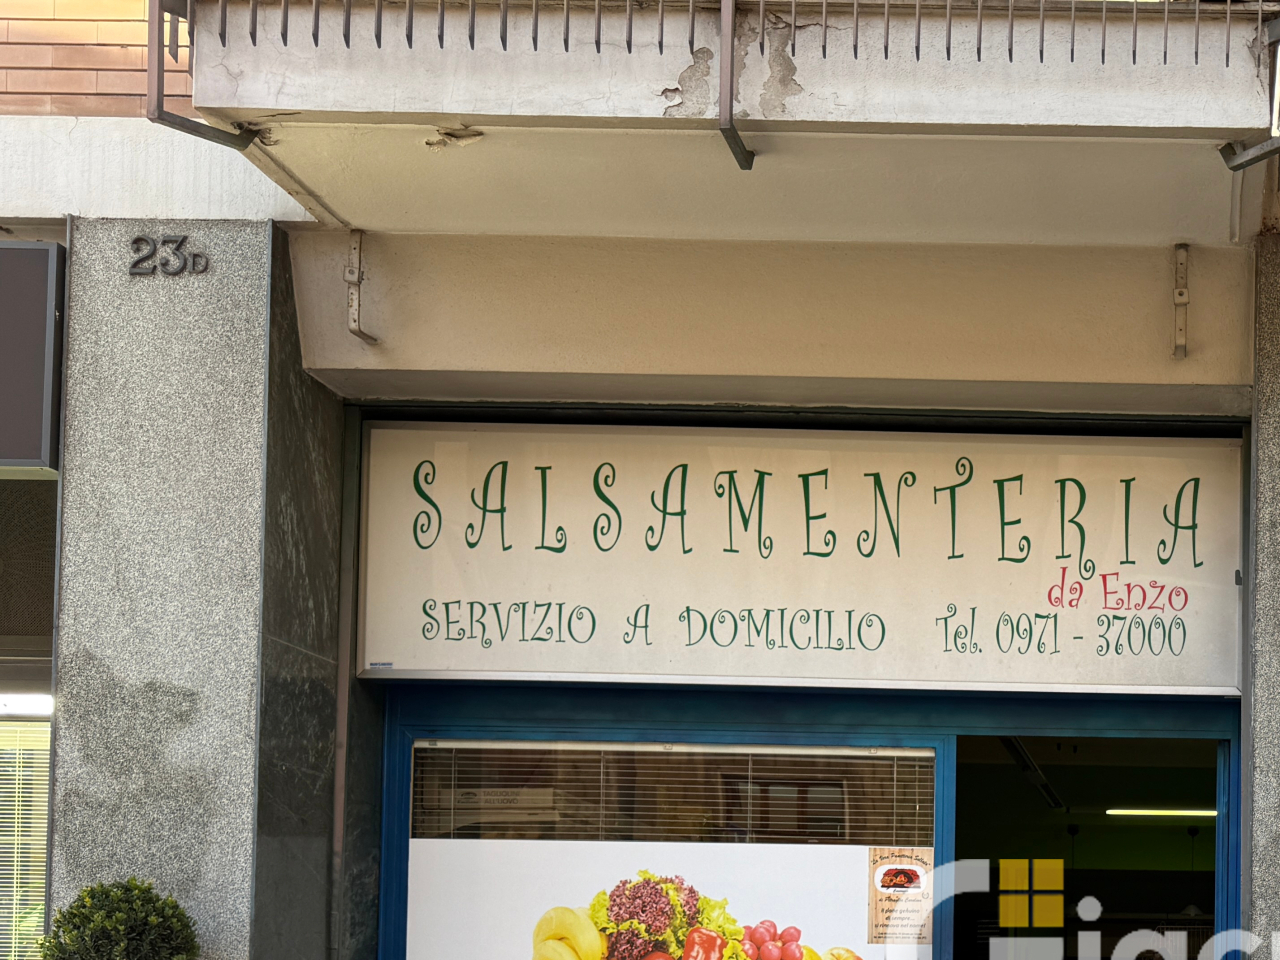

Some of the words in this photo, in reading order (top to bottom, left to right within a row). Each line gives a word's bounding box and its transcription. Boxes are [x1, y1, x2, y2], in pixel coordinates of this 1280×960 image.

[412, 456, 1204, 581] SALSAMENTERIA
[1047, 566, 1084, 609] da
[1098, 572, 1189, 612] Enzo
[421, 598, 596, 649] SERVIZIO
[622, 603, 653, 646] A
[678, 605, 886, 651] DOMICILIO
[935, 603, 983, 654] Tel.
[995, 611, 1061, 655] 0971
[1096, 614, 1187, 657] 37000
